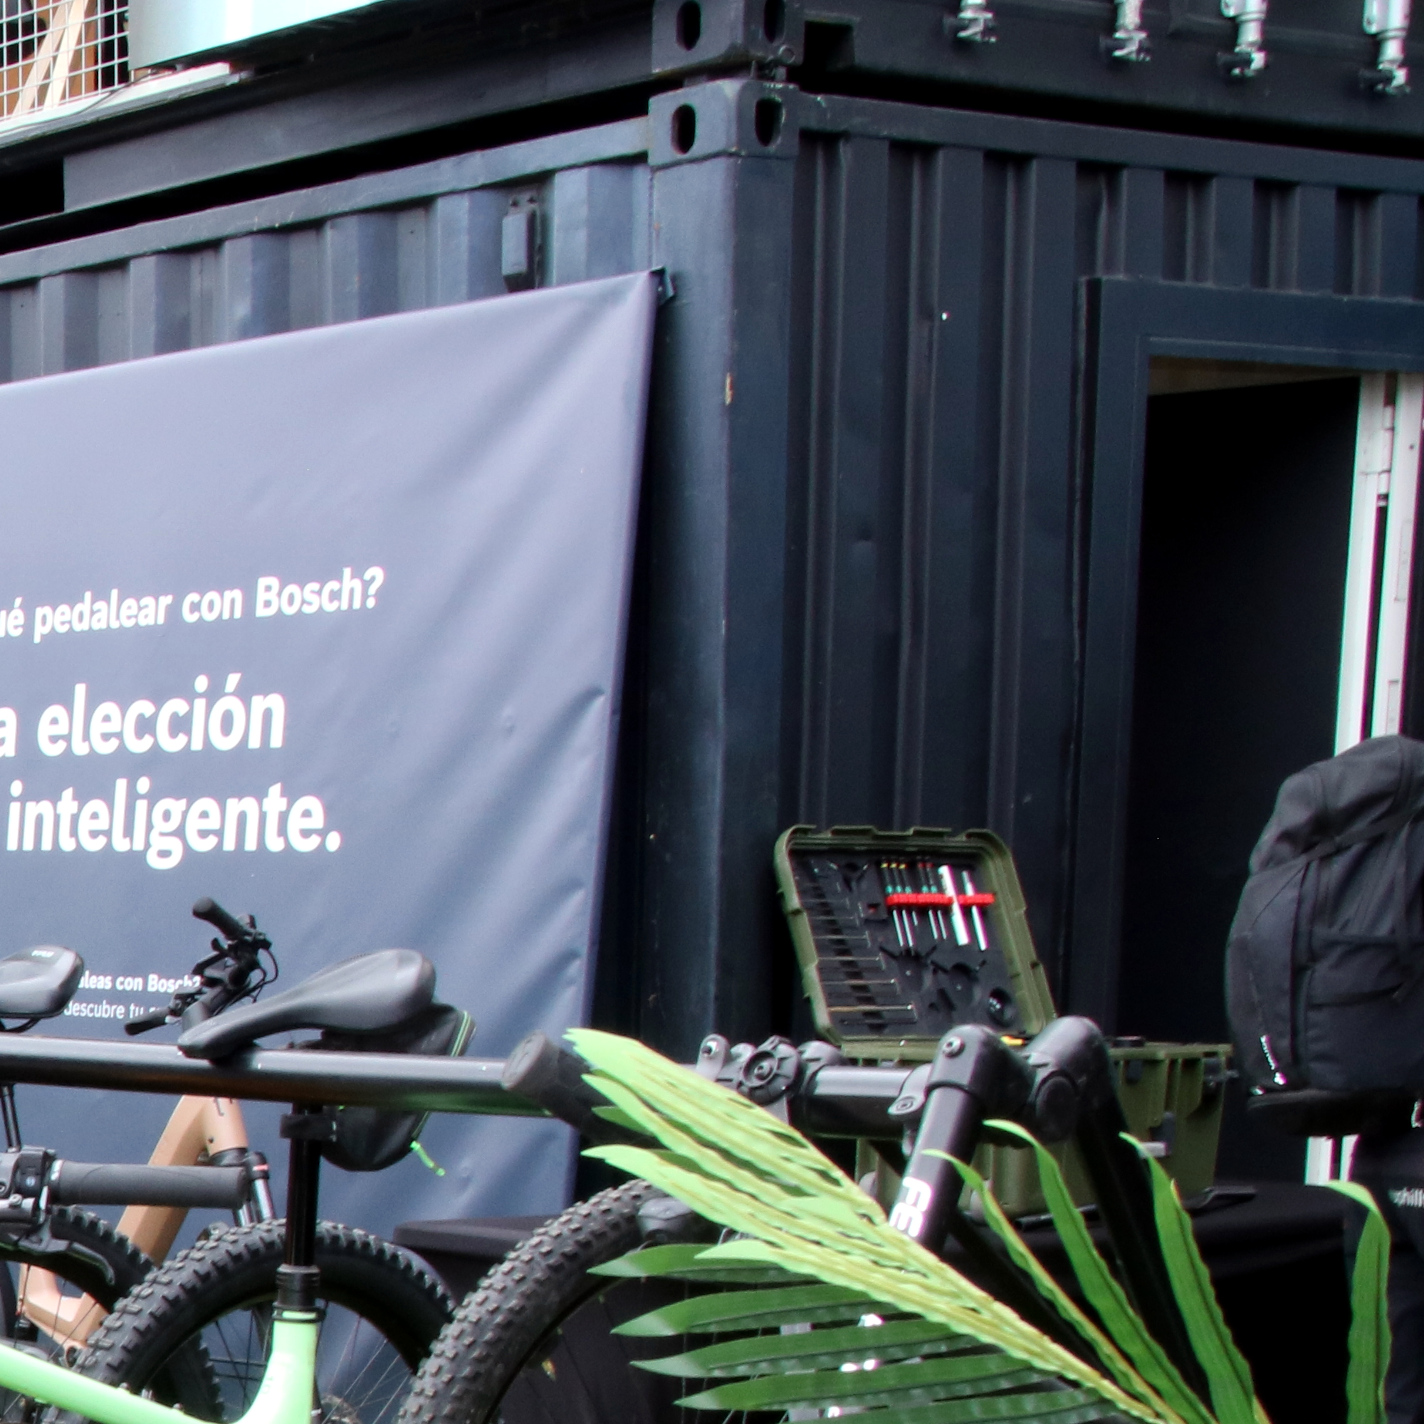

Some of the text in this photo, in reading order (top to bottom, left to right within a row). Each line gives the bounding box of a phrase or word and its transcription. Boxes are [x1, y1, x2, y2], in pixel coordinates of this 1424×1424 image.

[33, 588, 173, 643] pedalear
[182, 587, 243, 623] con
[255, 566, 385, 617] Bosch?
[37, 673, 285, 756] elección
[6, 776, 341, 869] inteligente.
[115, 975, 143, 992] con
